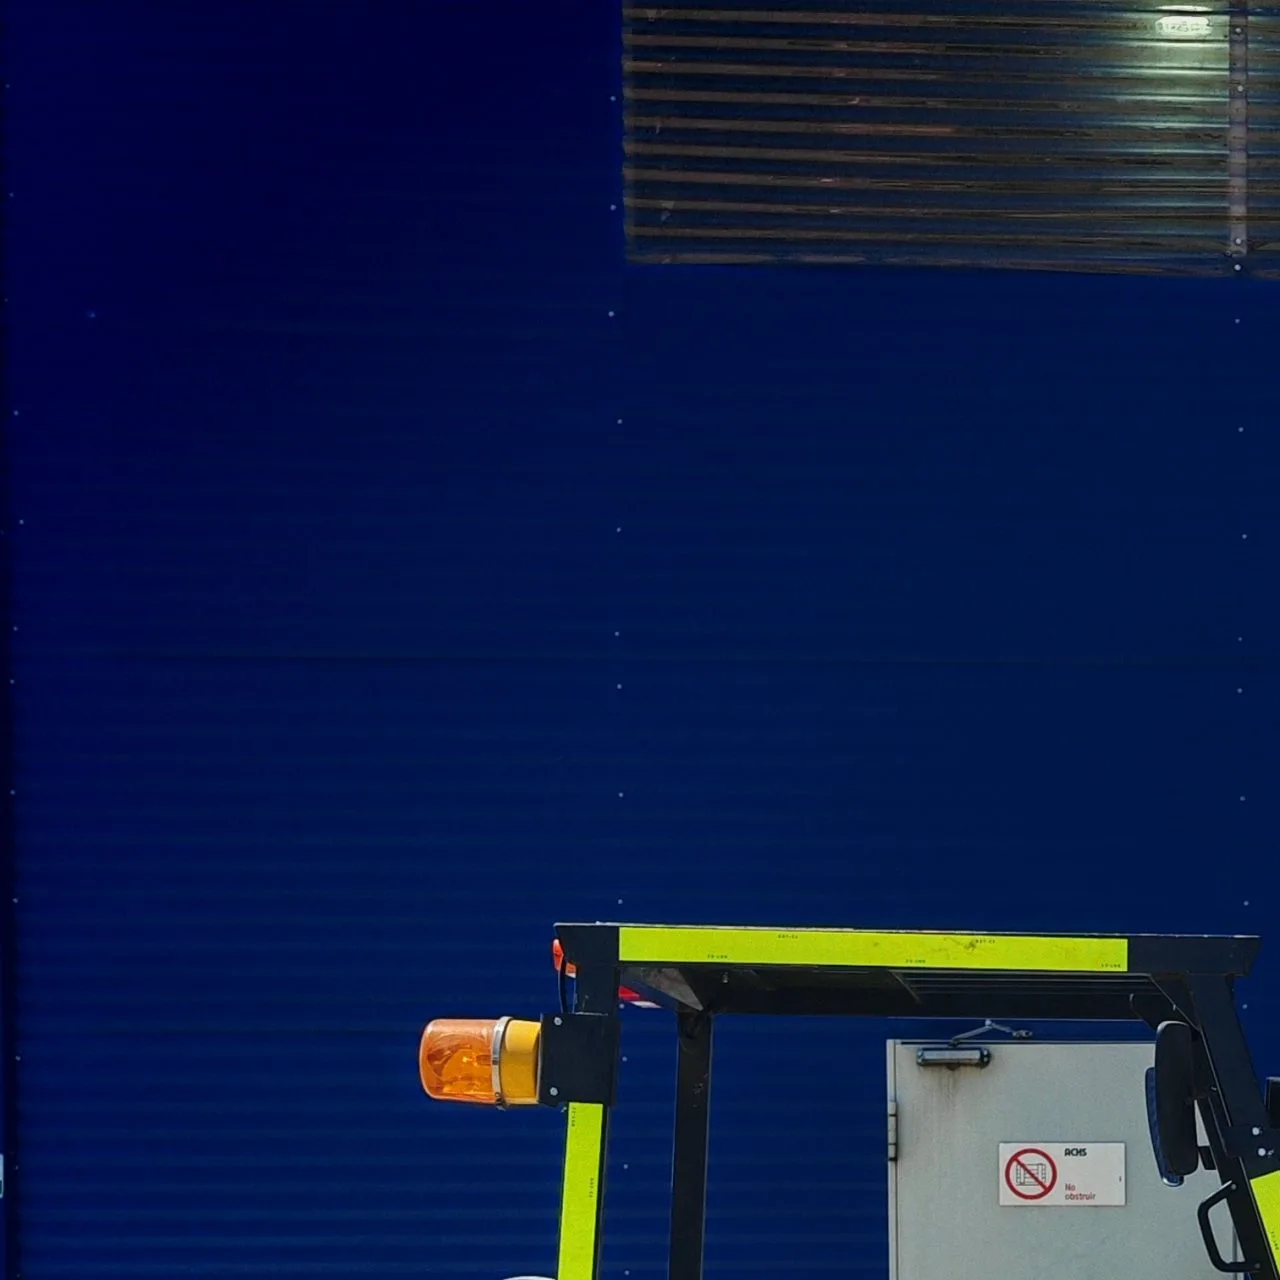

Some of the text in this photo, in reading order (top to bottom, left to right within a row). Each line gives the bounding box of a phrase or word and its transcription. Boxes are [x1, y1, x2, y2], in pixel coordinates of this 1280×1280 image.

[1064, 1148, 1087, 1157] ACHS
[1065, 1183, 1076, 1191] No
[1065, 1191, 1096, 1201] obstruir
